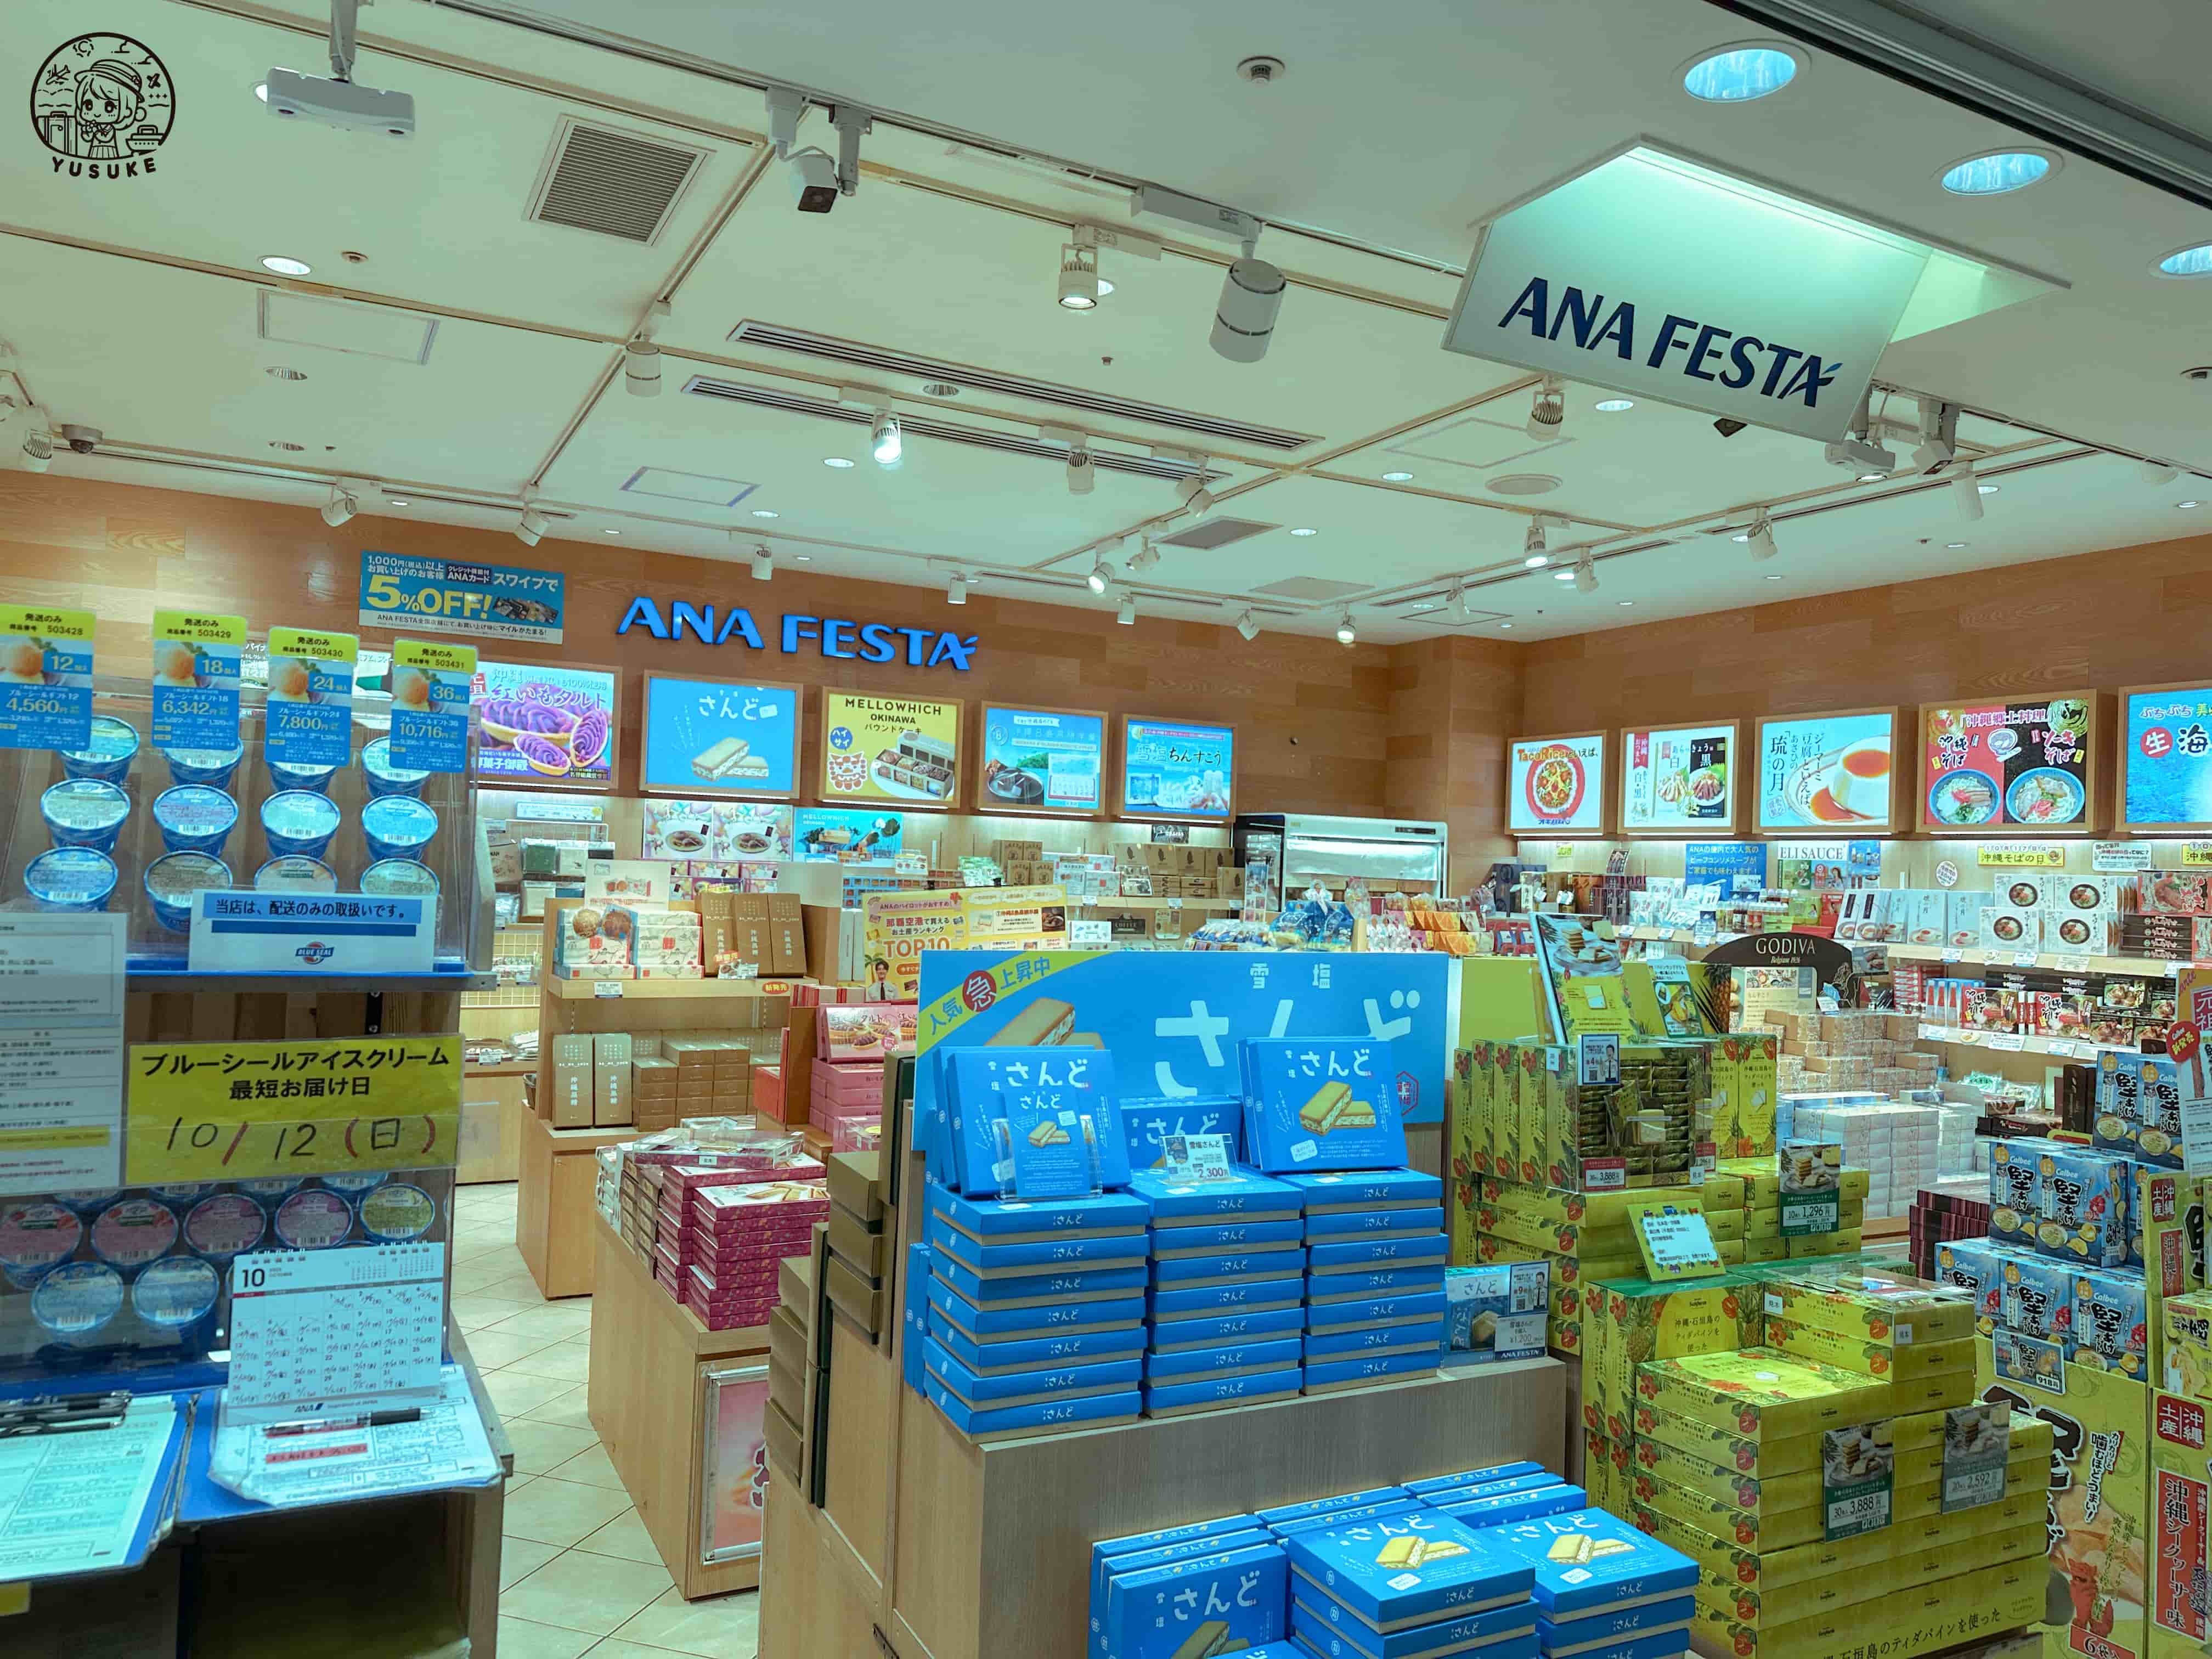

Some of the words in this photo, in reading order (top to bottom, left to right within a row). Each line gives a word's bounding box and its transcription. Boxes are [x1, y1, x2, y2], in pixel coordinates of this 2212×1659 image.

[1498, 276, 1635, 360] ANA
[1646, 314, 1843, 408] FESTA
[448, 572, 490, 584] ANAカード
[494, 573, 559, 592] スワイプで
[25, 613, 62, 623] 発送のみ
[184, 618, 219, 627] 発送のみ
[47, 625, 83, 635] 503428
[198, 629, 231, 639] 503429
[616, 597, 764, 649] ANA
[781, 614, 979, 670] FESTA
[297, 636, 330, 646] 発送のみ
[311, 647, 343, 657] 503430
[422, 648, 452, 657] 発送のみ
[435, 658, 465, 668] 503431
[491, 684, 607, 711] 紅いもタルト
[698, 695, 760, 721] さんど
[845, 698, 942, 715] MELLOWHICH
[870, 713, 916, 725] OKINAWA
[1938, 735, 1968, 752] 沖縄
[2146, 731, 2170, 755] 生
[2178, 724, 2208, 754] 海
[1790, 735, 1799, 770] あさひの
[1814, 732, 1825, 781] ジーマーミ
[2044, 747, 2076, 766] そば
[1940, 753, 1966, 770] そば
[1780, 848, 1801, 860] ELI
[1802, 847, 1844, 860] SAUCE
[1981, 853, 2045, 865] 沖縄そばの日
[215, 900, 406, 920] 当店は、配送のみの取扱いです。
[886, 917, 950, 927] 那覇空港で買える
[891, 926, 944, 936] お土産ランキング
[296, 949, 314, 958] BLUE
[316, 946, 334, 957] SEAL
[883, 937, 950, 958] TOP10
[1756, 938, 1816, 955] GODIVA
[929, 957, 1051, 1035] 人気急上昇中
[142, 1047, 450, 1077] ブルーシールアイスクリーム
[1300, 1048, 1370, 1077] さんど
[1006, 1059, 1088, 1088] さんど
[229, 1075, 370, 1100] 最短お届け日
[1019, 1094, 1062, 1109] さんど
[2010, 1156, 2031, 1165] Calbee
[2056, 1169, 2078, 1178] Calbee
[1367, 1187, 1389, 1198] さんど
[1057, 1213, 1084, 1225] さんど
[1222, 1229, 1245, 1240] さんど
[1375, 1245, 1396, 1256] さんど
[1954, 1261, 1976, 1272] Calbee
[241, 1268, 266, 1288] 10
[1055, 1277, 1081, 1289] さんど
[2020, 1276, 2044, 1288] Calbee
[1464, 1279, 1498, 1295] さんど
[1223, 1290, 1246, 1301] さんど
[2093, 1292, 2119, 1304] Calbee
[1373, 1304, 1394, 1314] さんど
[1054, 1340, 1081, 1353] さんど
[1687, 1342, 1708, 1352] 使った
[1220, 1351, 1243, 1363] さんど
[1365, 1361, 1387, 1373] さんど
[294, 1404, 317, 1413] ANA
[1046, 1406, 1074, 1419] さんど
[2159, 1403, 2179, 1436] 土産
[2087, 1432, 2108, 1522] 噛むほどうまい!
[1346, 1514, 1435, 1541] さんど
[1515, 1513, 1600, 1539] さんど
[1174, 1571, 1260, 1620] さんど
[1617, 1615, 1640, 1629] さんど
[1454, 1623, 1479, 1638] さんど
